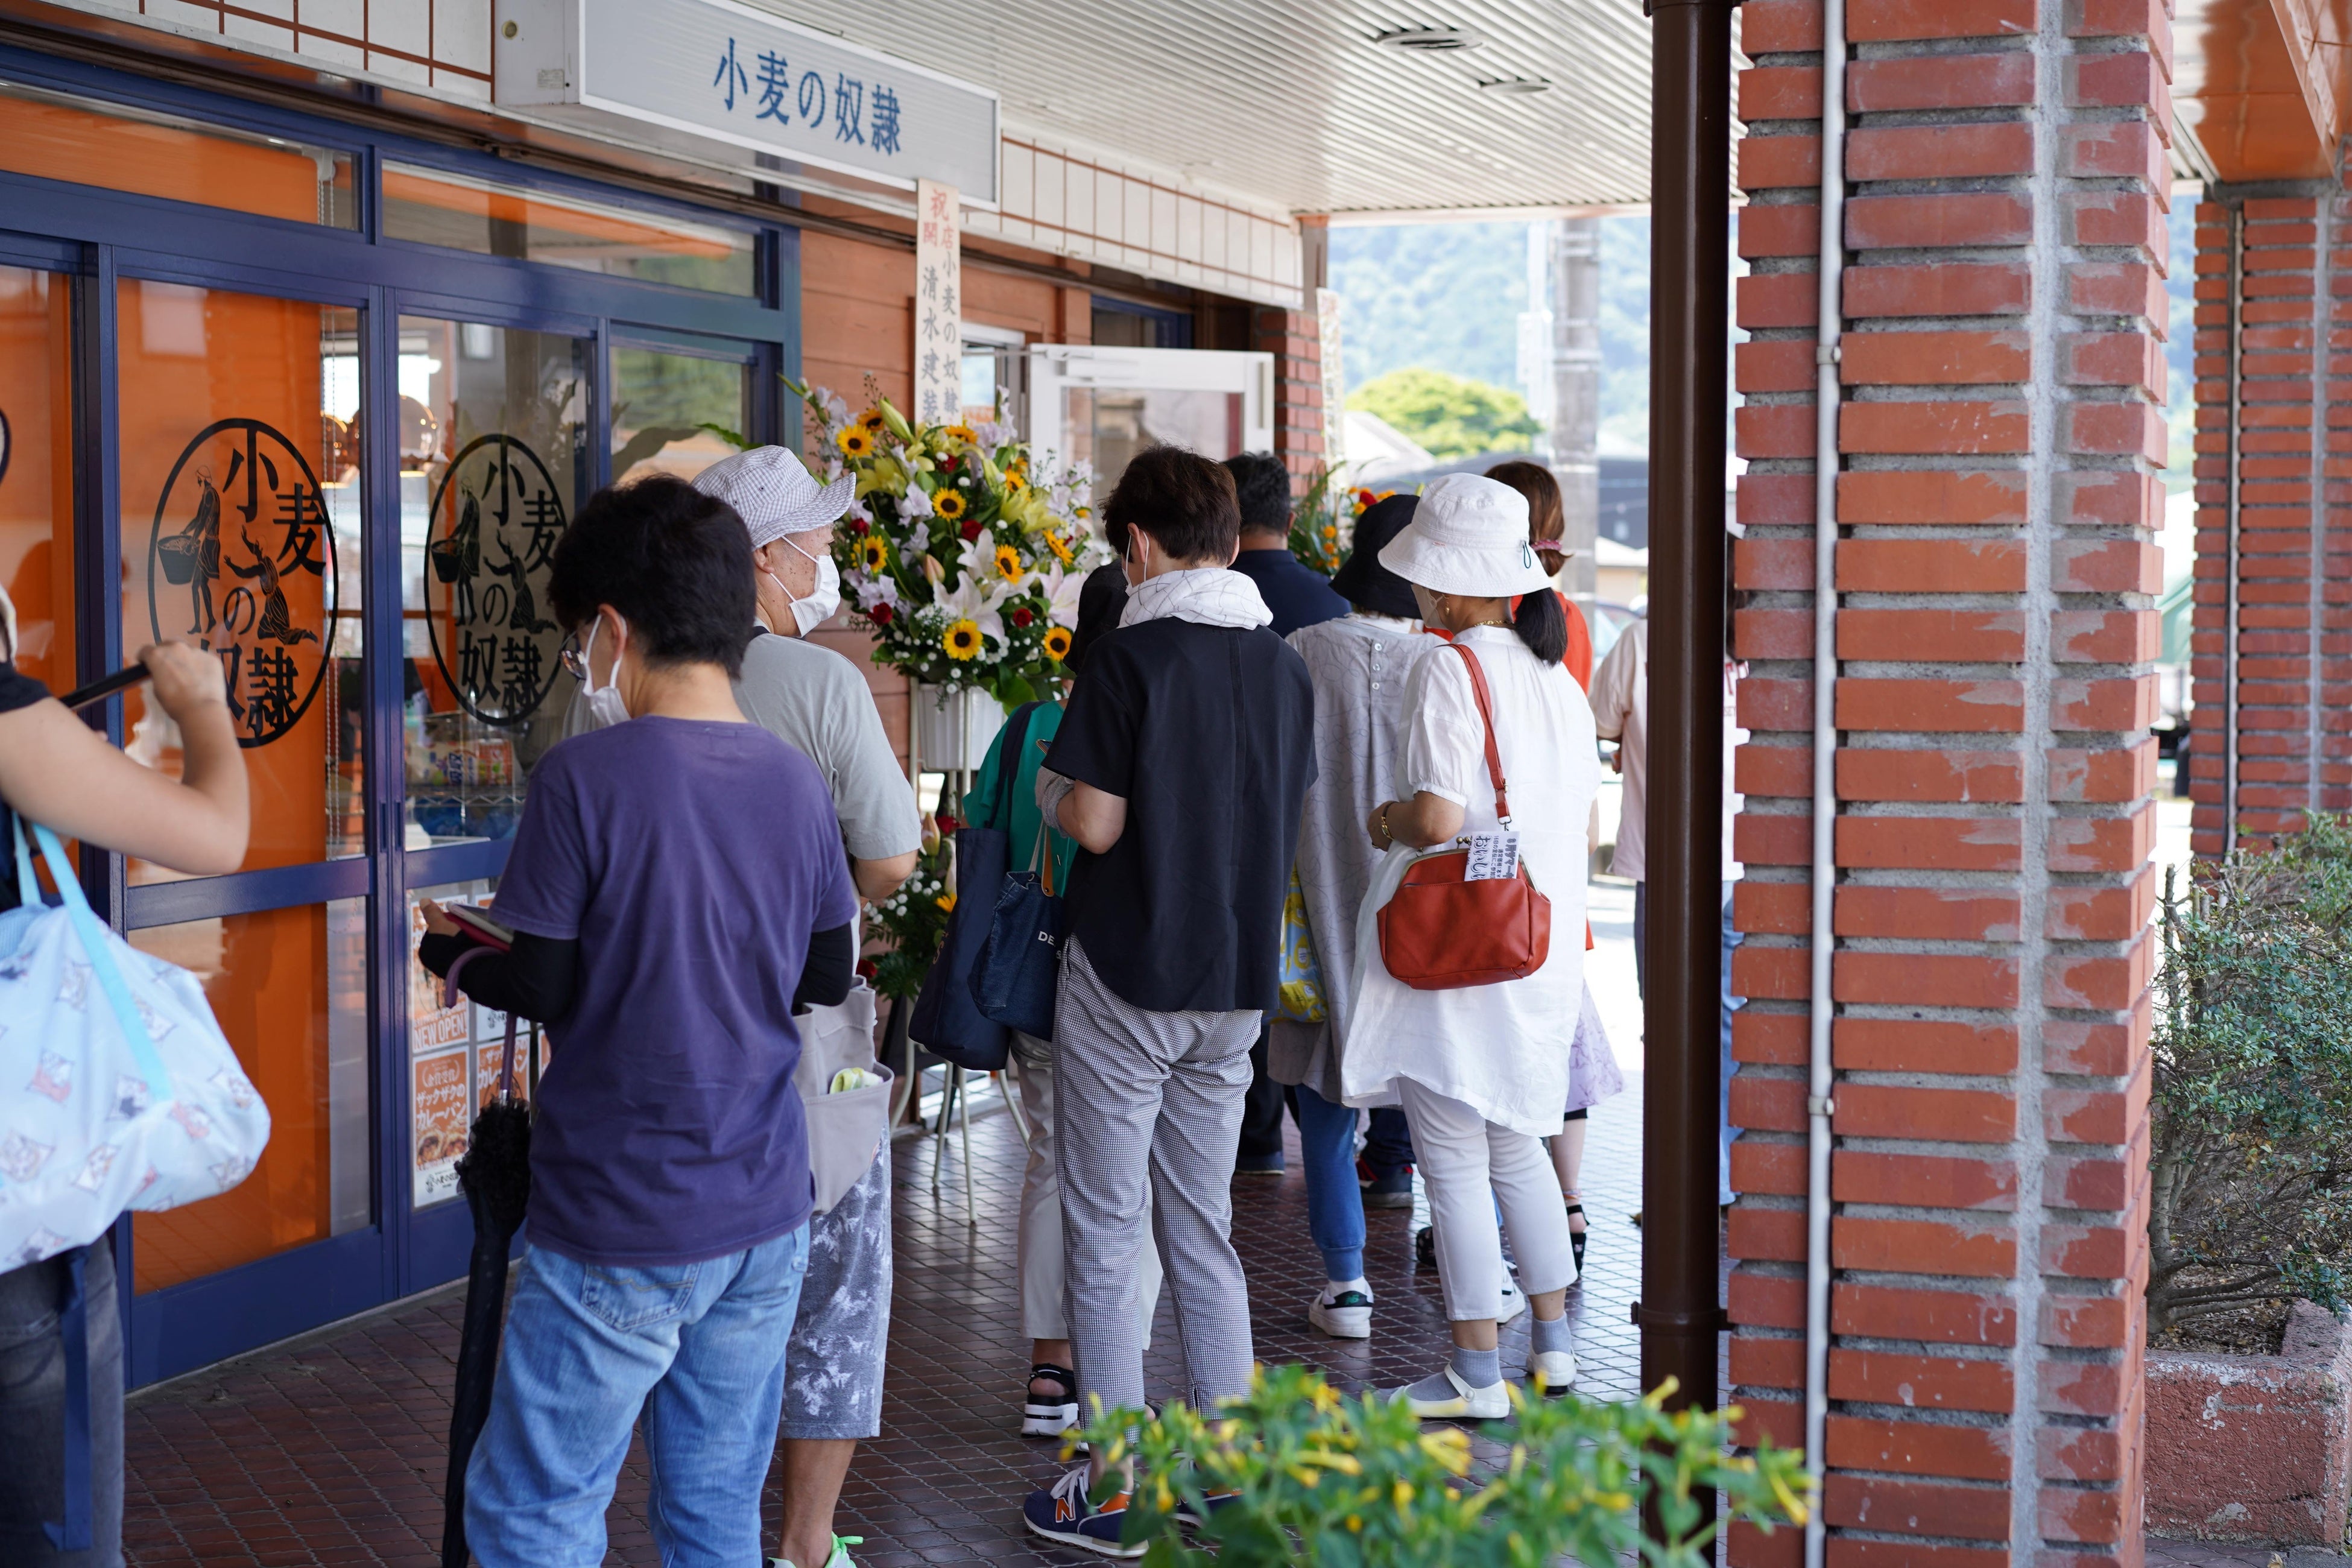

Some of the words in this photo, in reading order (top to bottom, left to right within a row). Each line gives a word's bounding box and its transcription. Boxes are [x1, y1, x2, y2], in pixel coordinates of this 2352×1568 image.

[714, 37, 901, 156] 小麦の奴隷
[414, 1021, 437, 1049] NEW
